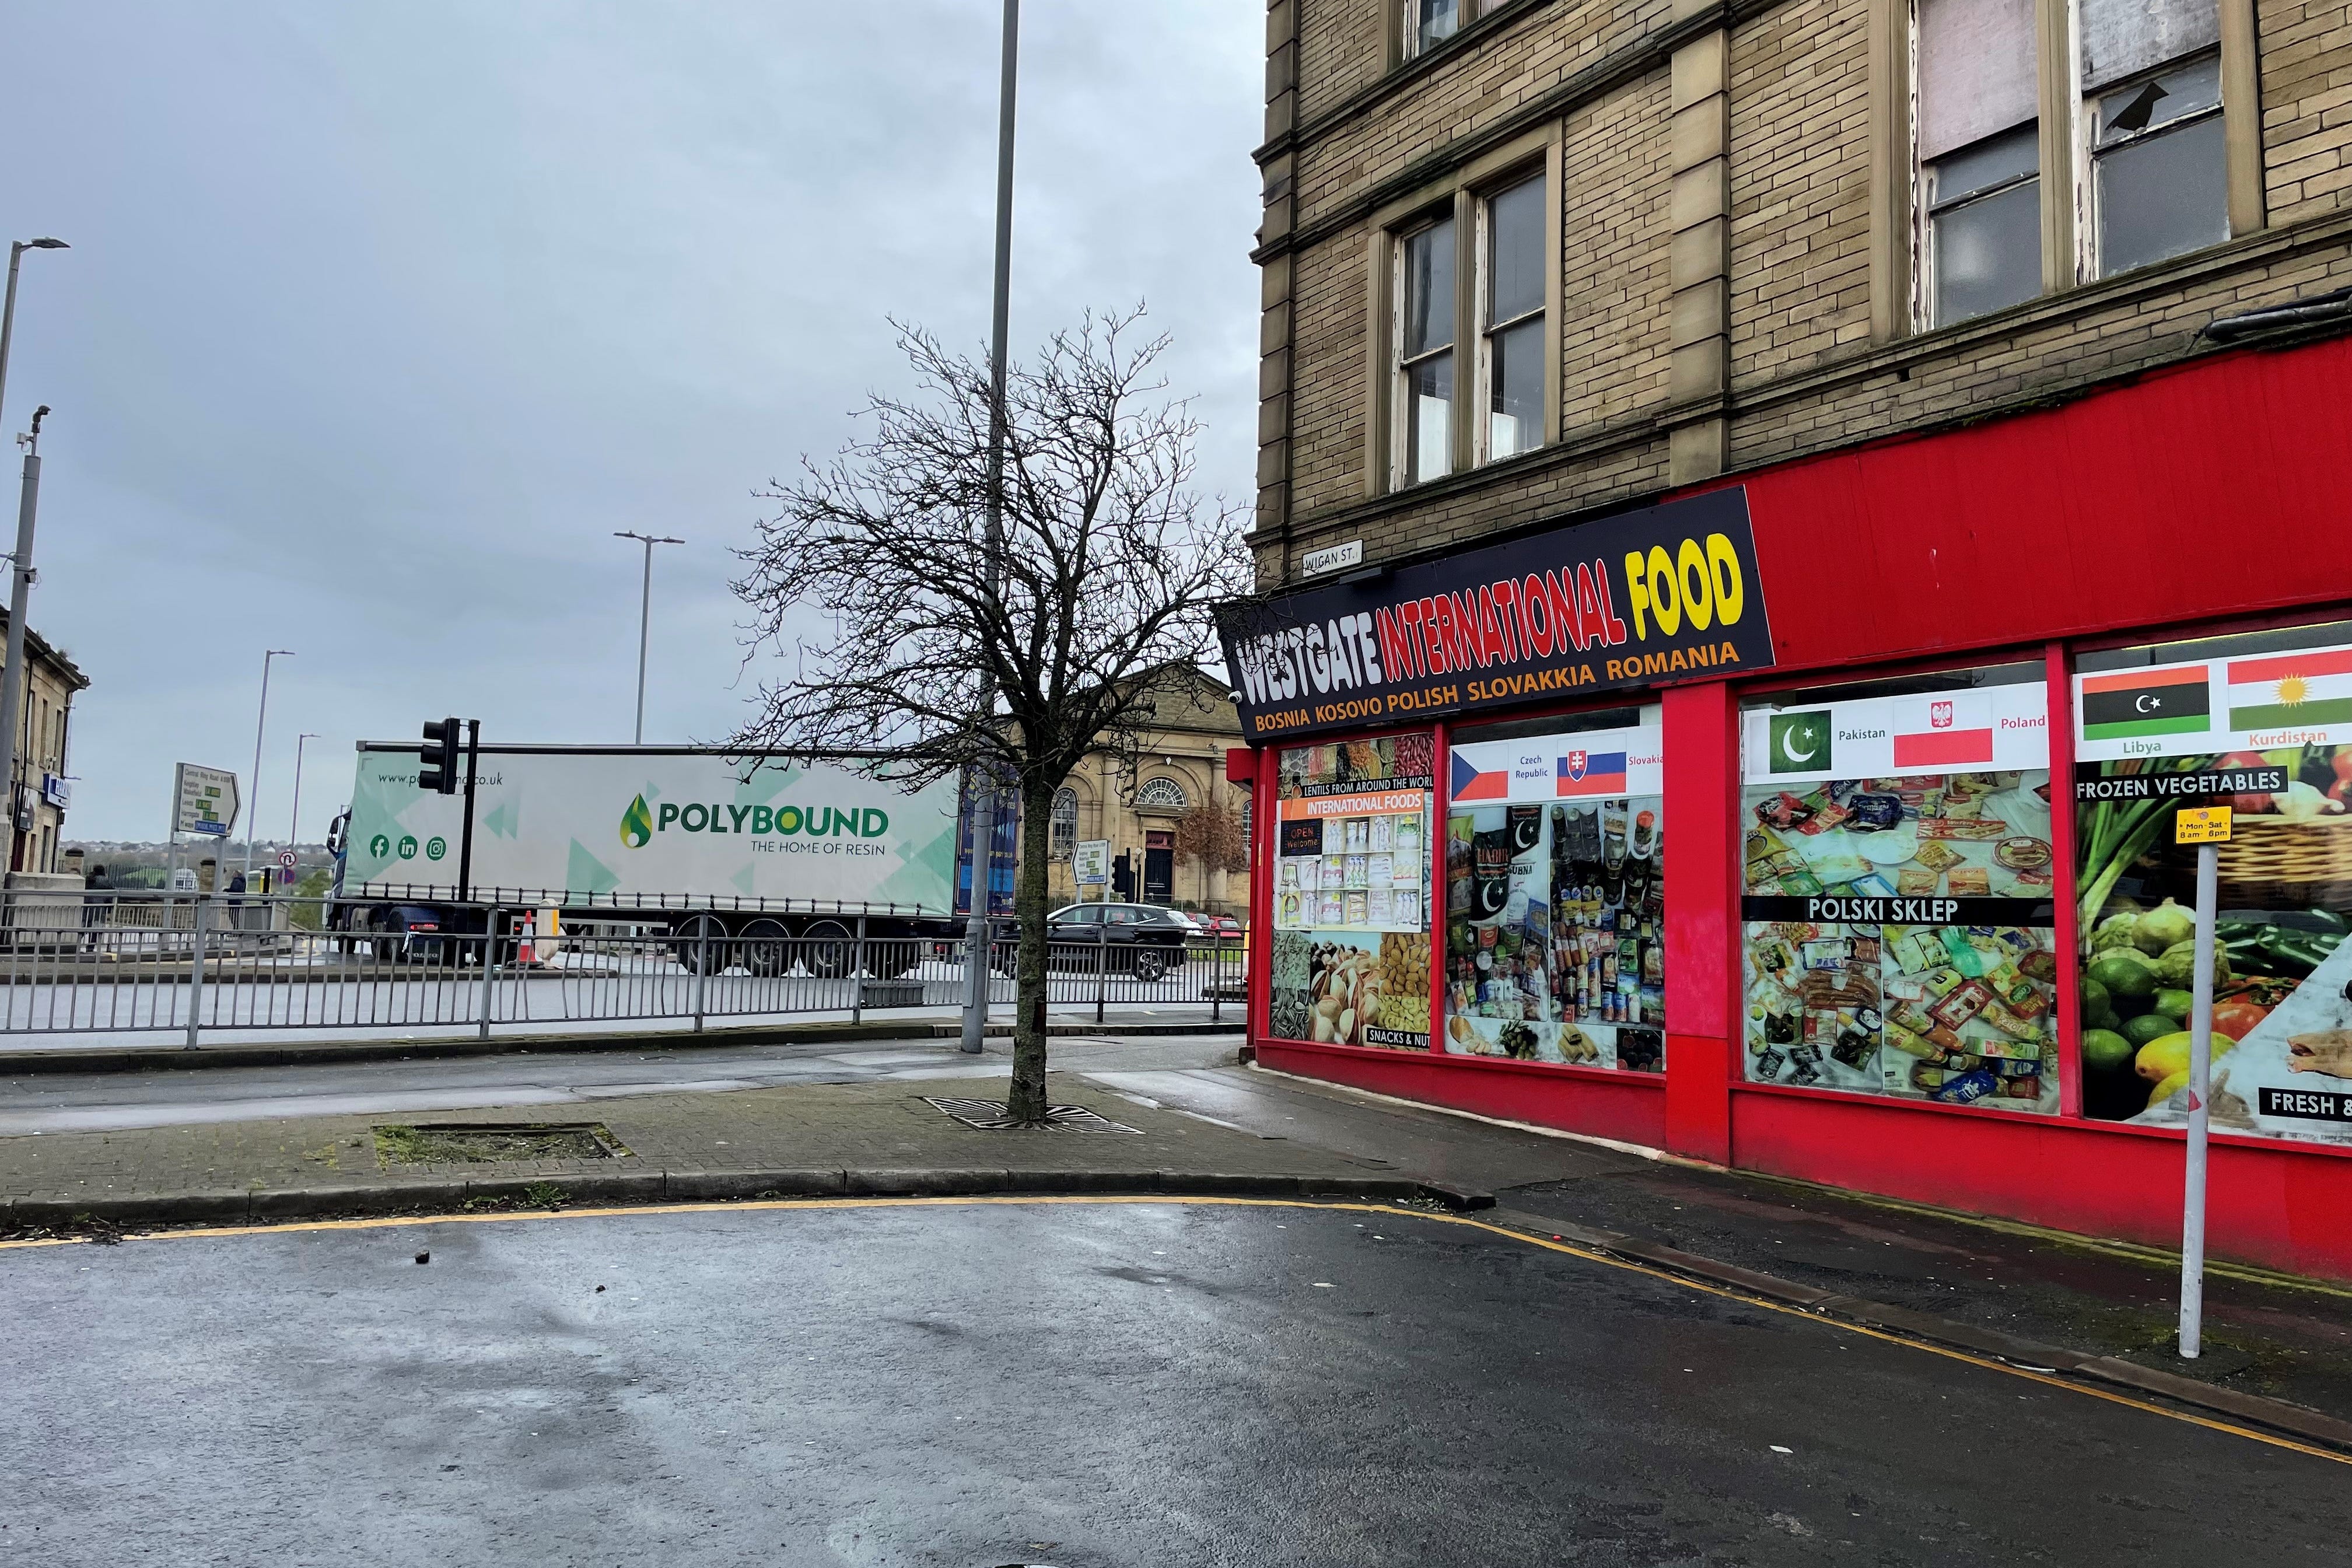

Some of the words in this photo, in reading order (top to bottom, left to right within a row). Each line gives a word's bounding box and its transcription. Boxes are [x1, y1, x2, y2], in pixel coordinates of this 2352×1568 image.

[1306, 551, 1338, 570] WIGAN
[1235, 611, 1382, 705] WESTGATE
[1376, 558, 1627, 684] INTERNATIONAL
[1625, 533, 1744, 641] FOOD
[1255, 708, 1311, 732] BOSNIA
[1315, 696, 1382, 723] KOSOVO
[1388, 684, 1459, 713] POLISH
[1467, 664, 1596, 701] SLOVAKKIA
[1607, 641, 1741, 681] ROMANIA
[2001, 715, 2046, 729] Poland
[1839, 728, 1886, 741] Pakistan
[2249, 730, 2328, 746] Kurdistan
[2123, 741, 2162, 755] Libya
[1520, 754, 1542, 765] Czech
[1516, 769, 1548, 779] Republic
[1304, 785, 1330, 797] LENTILS
[1332, 782, 1354, 794] FROM
[1356, 779, 1391, 792] AROUND
[1392, 778, 1407, 789] THE
[2077, 779, 2148, 799] FROZEN
[2154, 772, 2281, 794] VEGETABLES
[1307, 796, 1383, 816] INTERNATIONAL
[1384, 793, 1422, 810] FOODS
[657, 803, 889, 838] POLYBOUND
[1291, 827, 1314, 839] OPEN
[751, 841, 775, 852] THE
[780, 841, 819, 853] HOME
[823, 842, 842, 855] OF
[846, 844, 885, 856] RESIN
[1809, 898, 1884, 921] POLSKI
[1891, 900, 1958, 922] SKLEP
[1370, 1030, 1404, 1044] SNACKS
[1406, 1034, 1412, 1045] &
[2272, 1092, 2334, 1115] FRESH
